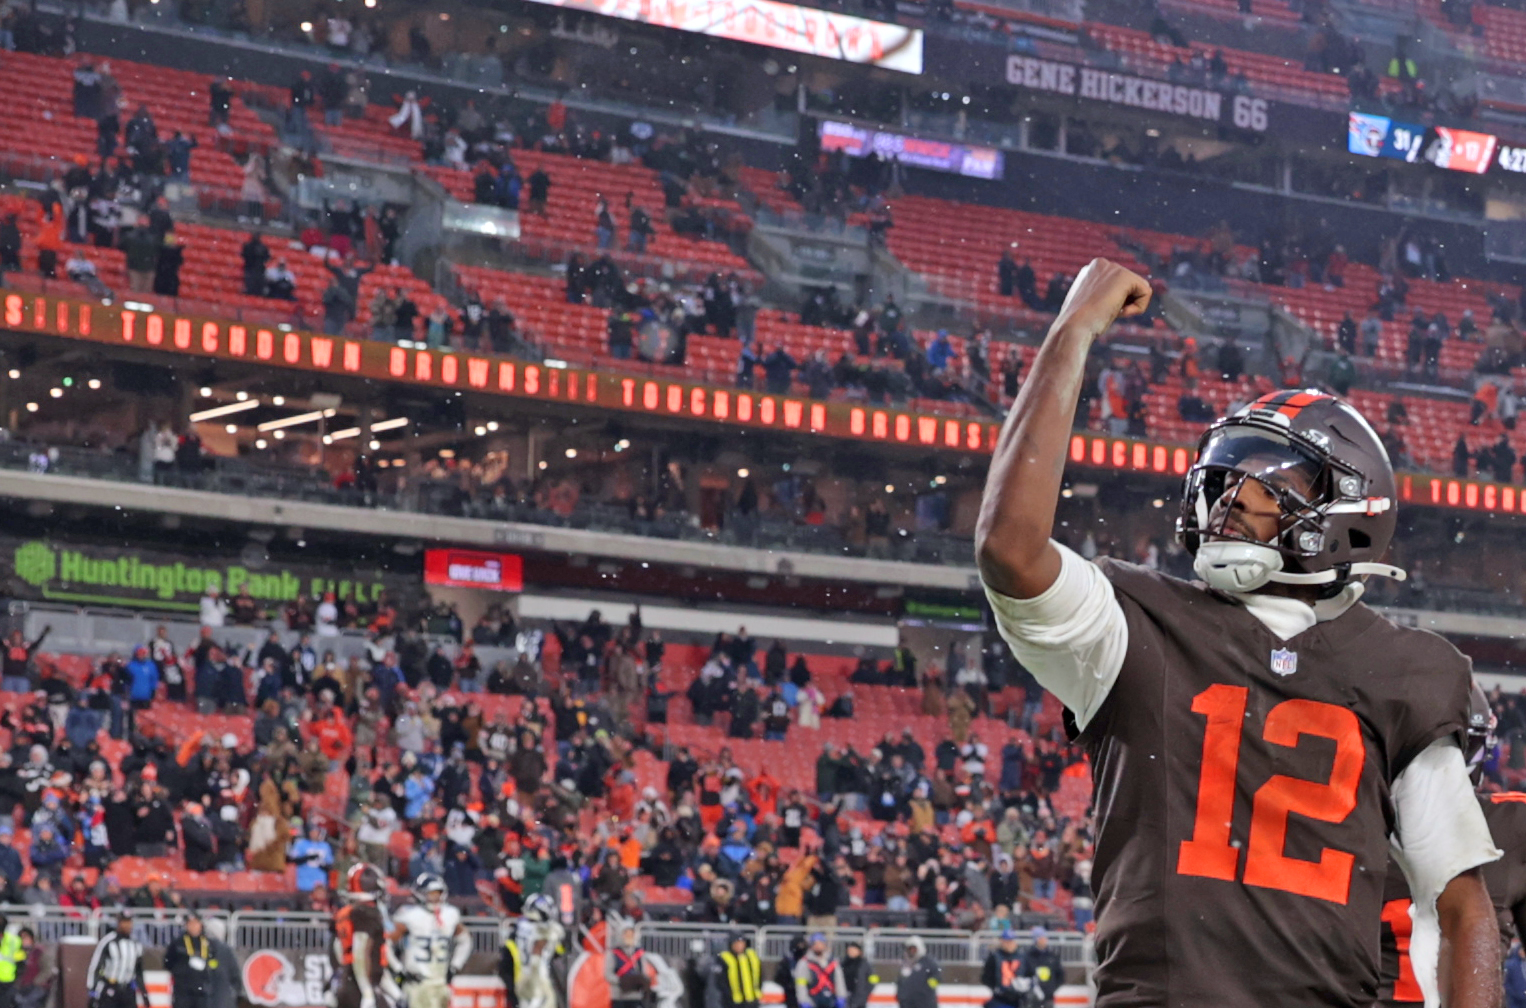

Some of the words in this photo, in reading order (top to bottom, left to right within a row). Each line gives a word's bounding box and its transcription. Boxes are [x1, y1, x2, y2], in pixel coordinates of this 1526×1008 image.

[1006, 54, 1075, 95] GENE
[1080, 67, 1222, 121] HICKERSON
[1233, 94, 1268, 131] 66
[1393, 128, 1411, 151] 31
[120, 310, 362, 372] TOUCHDOWN
[622, 378, 826, 432] TOUCHDOWN
[1070, 435, 1198, 475] OUCHDO
[60, 551, 223, 599] Huntington
[227, 564, 300, 601] Bank
[1274, 659, 1296, 671] NFL
[1177, 683, 1366, 906] 12
[414, 934, 450, 963] 33
